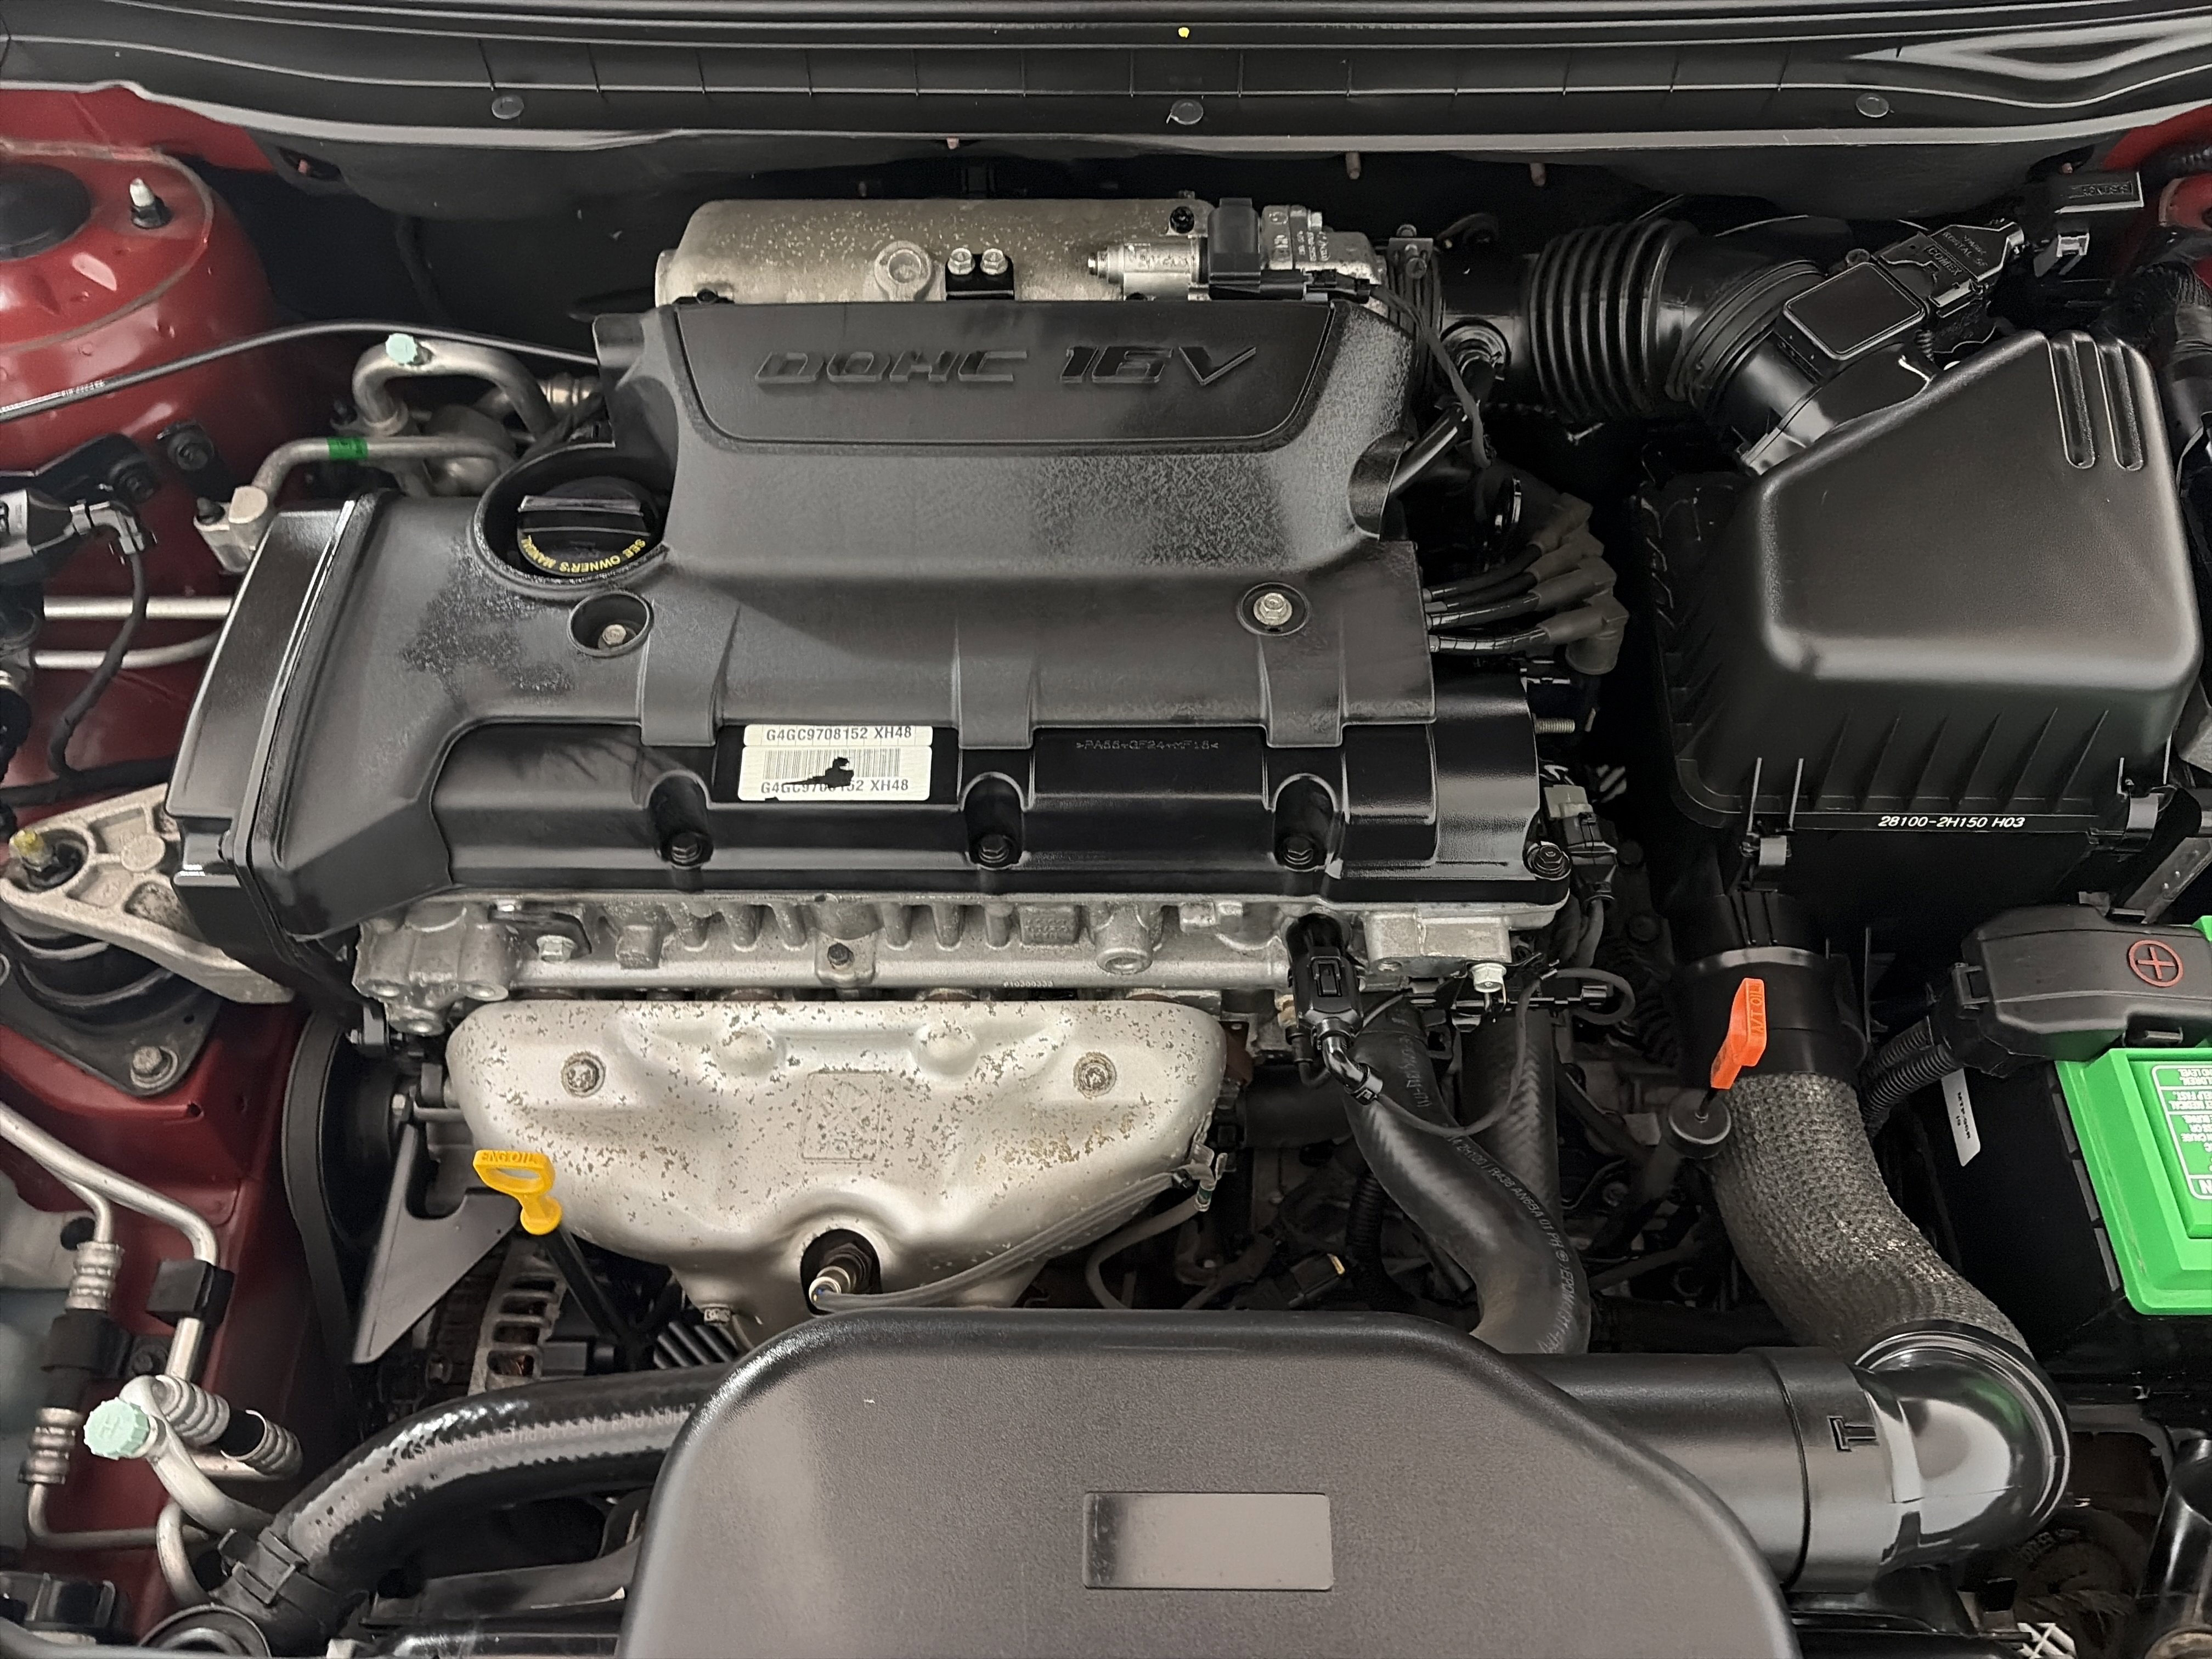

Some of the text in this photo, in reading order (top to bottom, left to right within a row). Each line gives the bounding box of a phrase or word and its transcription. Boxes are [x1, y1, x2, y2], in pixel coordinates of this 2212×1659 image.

[754, 346, 1257, 386] DOHC 16V
[622, 538, 646, 559] SEE
[559, 555, 621, 573] OWNER'S
[766, 725, 912, 742] G4GC9708152 XH48
[870, 778, 909, 792] XH48
[1877, 815, 2026, 828] 28100-2H150 H03
[1749, 984, 1765, 1036] A/T OIL
[510, 1152, 537, 1164] OIL
